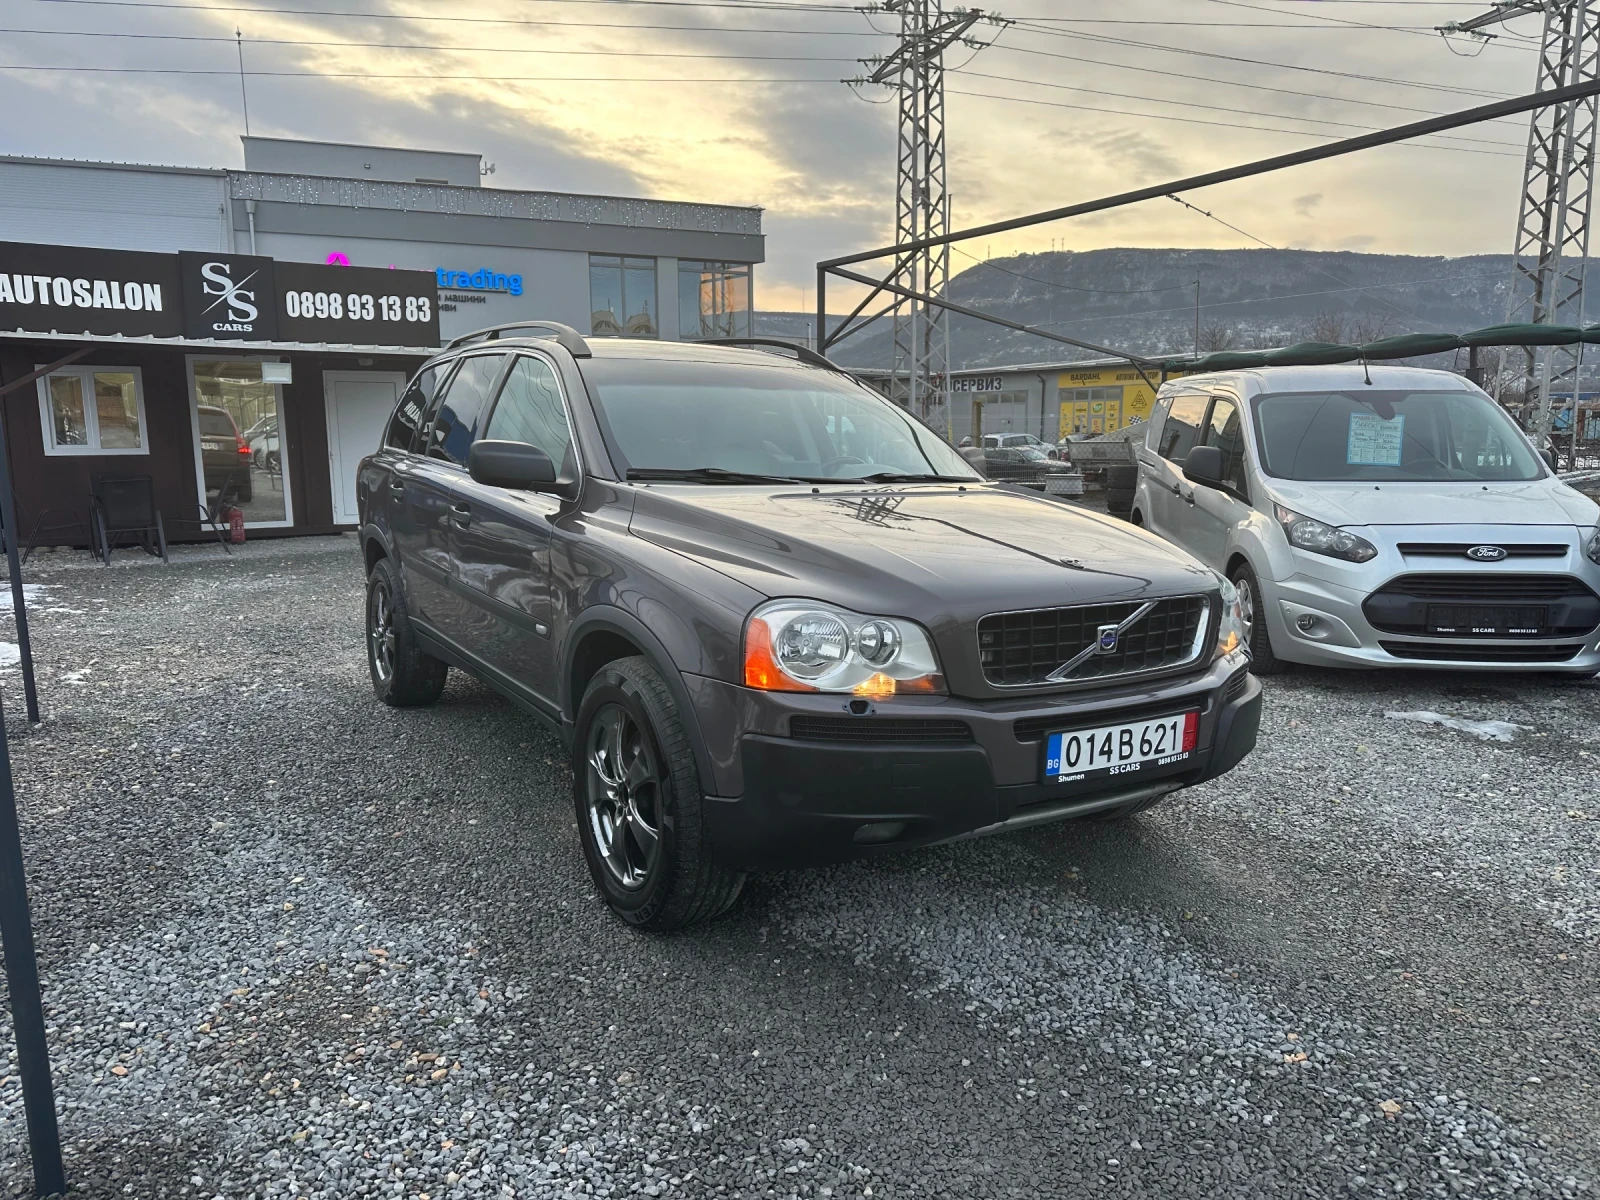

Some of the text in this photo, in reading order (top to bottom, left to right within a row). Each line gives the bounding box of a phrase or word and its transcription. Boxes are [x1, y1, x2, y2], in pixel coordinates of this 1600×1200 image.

[435, 266, 524, 297] trading
[0, 273, 163, 312] AUTOSALON
[444, 293, 487, 304] машини
[285, 290, 431, 323] 0898 93 13 83
[212, 322, 254, 332] CARS
[1070, 372, 1102, 385] BARDAHL
[1477, 547, 1499, 557] Ford
[1046, 758, 1060, 770] BG
[1109, 762, 1141, 776] SS CARS
[1057, 773, 1086, 784] Shumen
